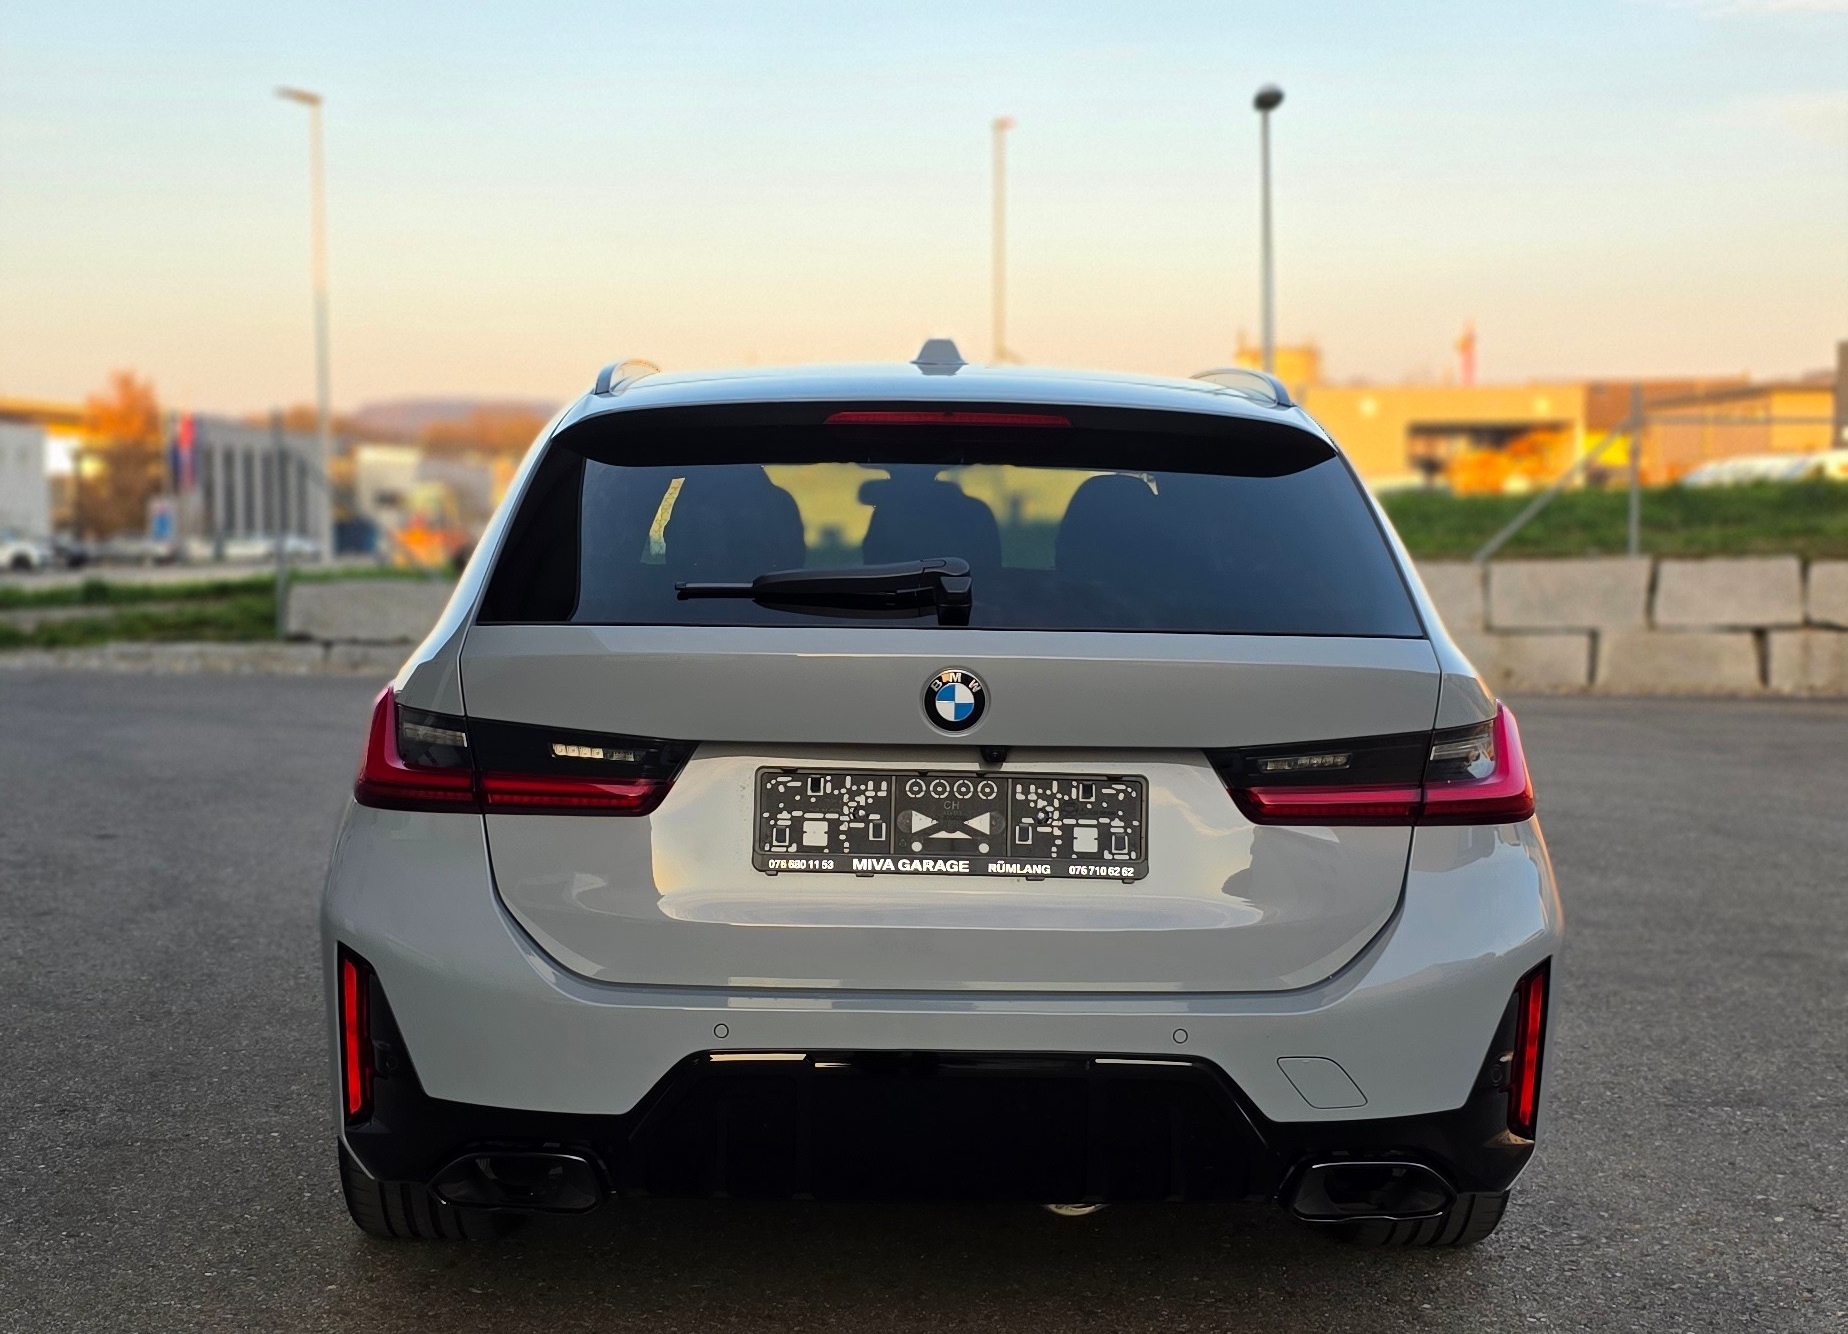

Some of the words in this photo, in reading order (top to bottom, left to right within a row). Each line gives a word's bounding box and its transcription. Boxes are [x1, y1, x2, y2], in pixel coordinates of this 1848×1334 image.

[930, 672, 982, 693] BMW
[943, 800, 960, 810] CH
[808, 859, 819, 870] 11
[852, 858, 895, 871] MIVA
[897, 858, 970, 873] GARAGE
[987, 860, 1051, 875] RÜMLANG
[1068, 865, 1088, 876] 076
[1089, 865, 1106, 877] 710
[1121, 866, 1134, 878] 62
